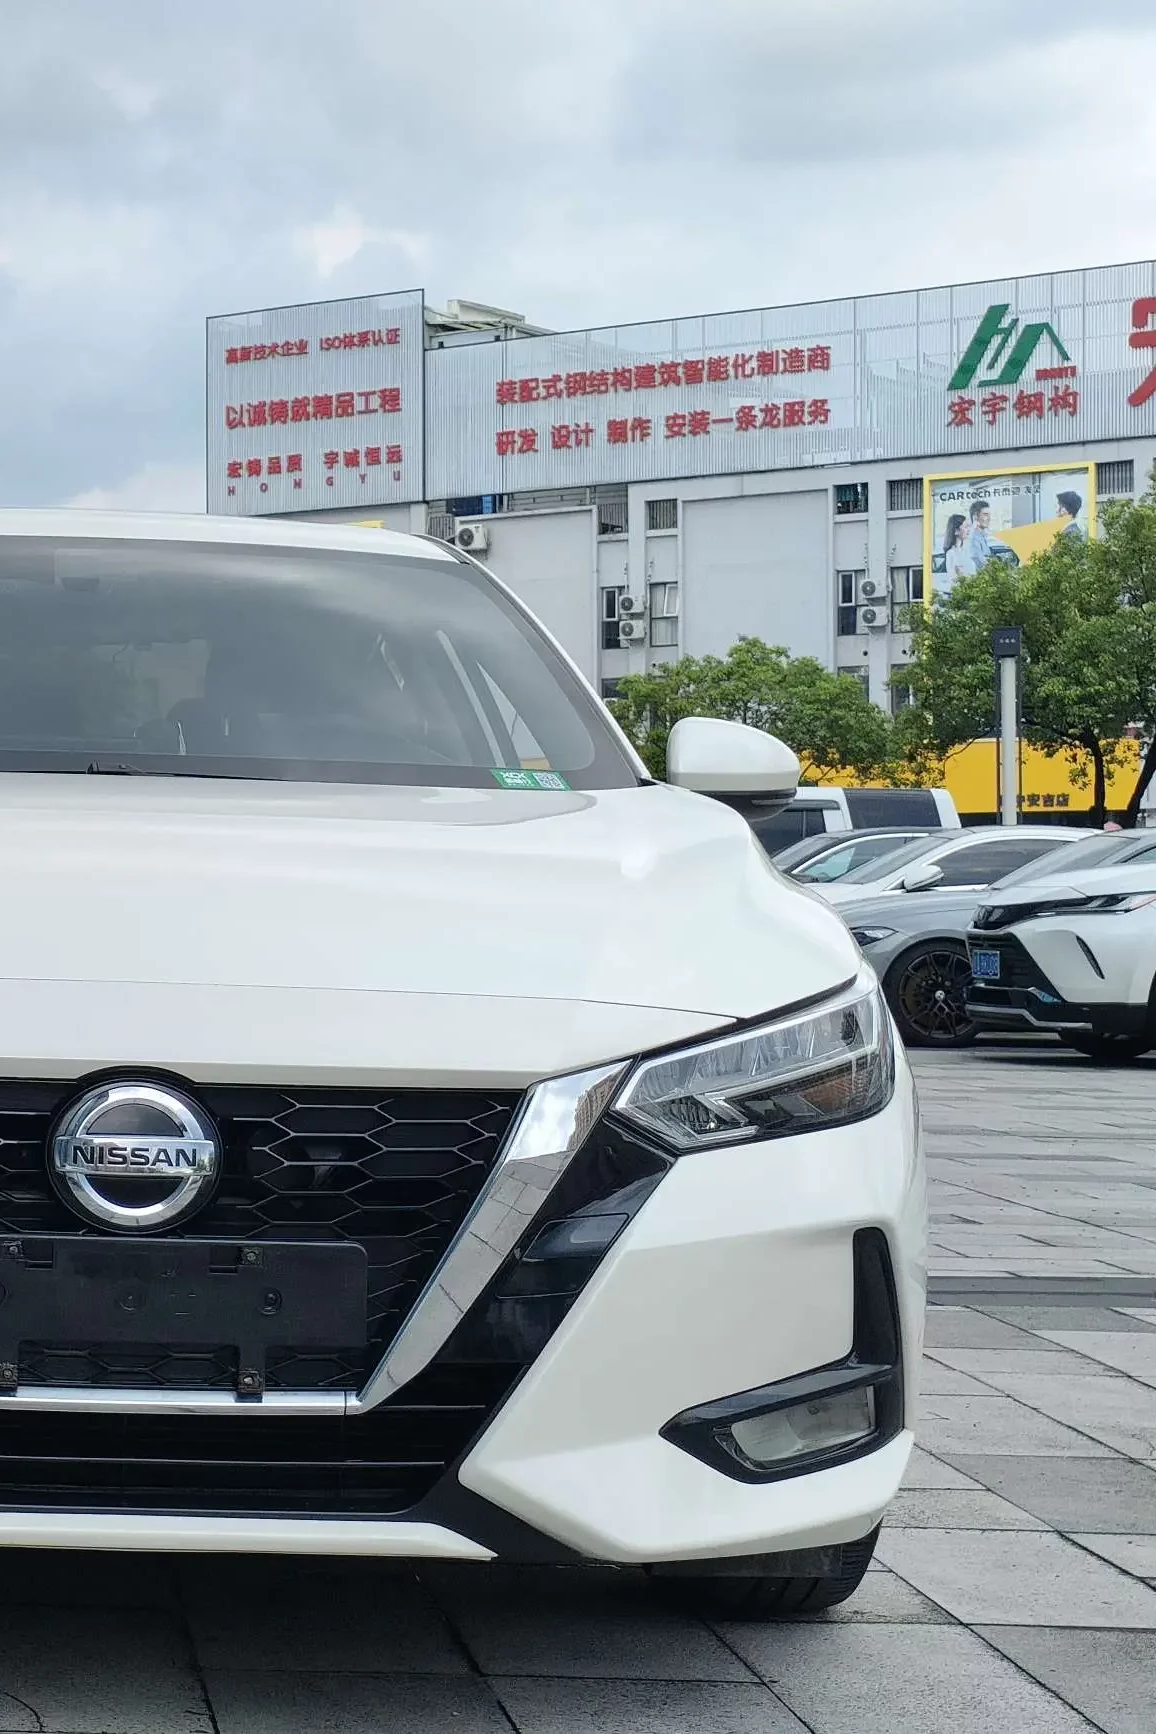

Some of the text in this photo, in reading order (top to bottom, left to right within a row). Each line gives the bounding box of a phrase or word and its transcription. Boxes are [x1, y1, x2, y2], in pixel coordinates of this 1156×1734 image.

[496, 345, 832, 405] 装配式钢结构建筑智能化制造商
[226, 387, 402, 429] 以诚铸就精品工程
[496, 399, 832, 456] 研发 设计 制作 安装一条龙服务
[72, 1145, 197, 1167] NISSAN
